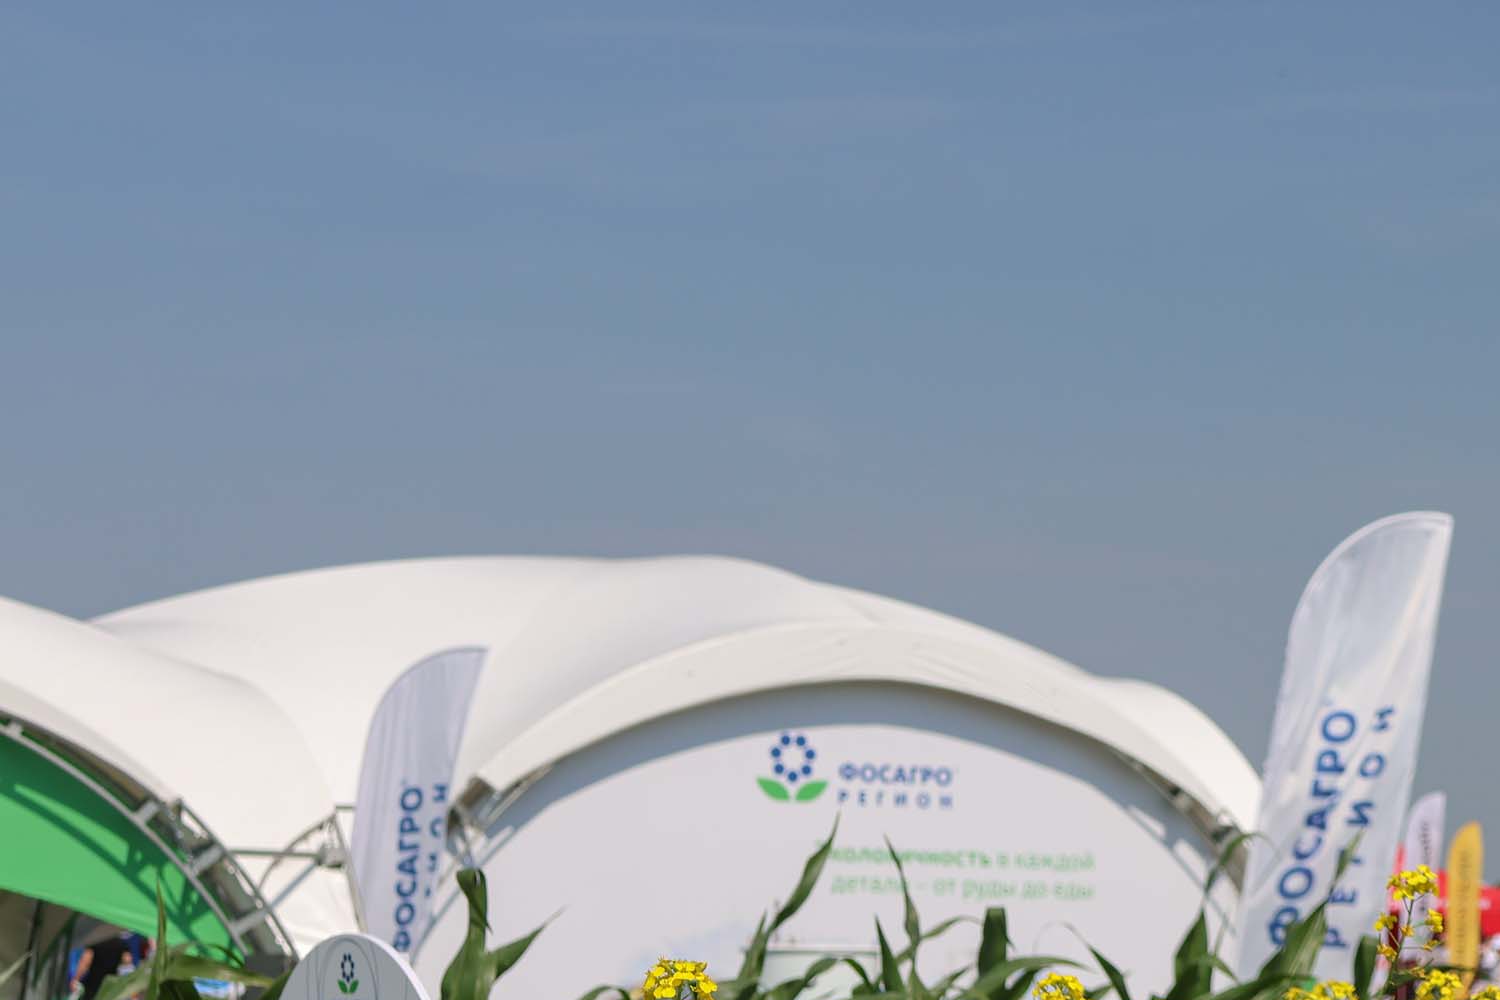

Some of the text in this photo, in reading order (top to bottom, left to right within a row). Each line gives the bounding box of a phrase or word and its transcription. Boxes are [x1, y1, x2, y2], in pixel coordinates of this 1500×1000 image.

[838, 763, 953, 787] ФОСАГРО
[838, 789, 953, 809] РЕГИОН
[394, 786, 424, 952] ФОСАГРО
[1269, 709, 1357, 947] ФОСАГРО
